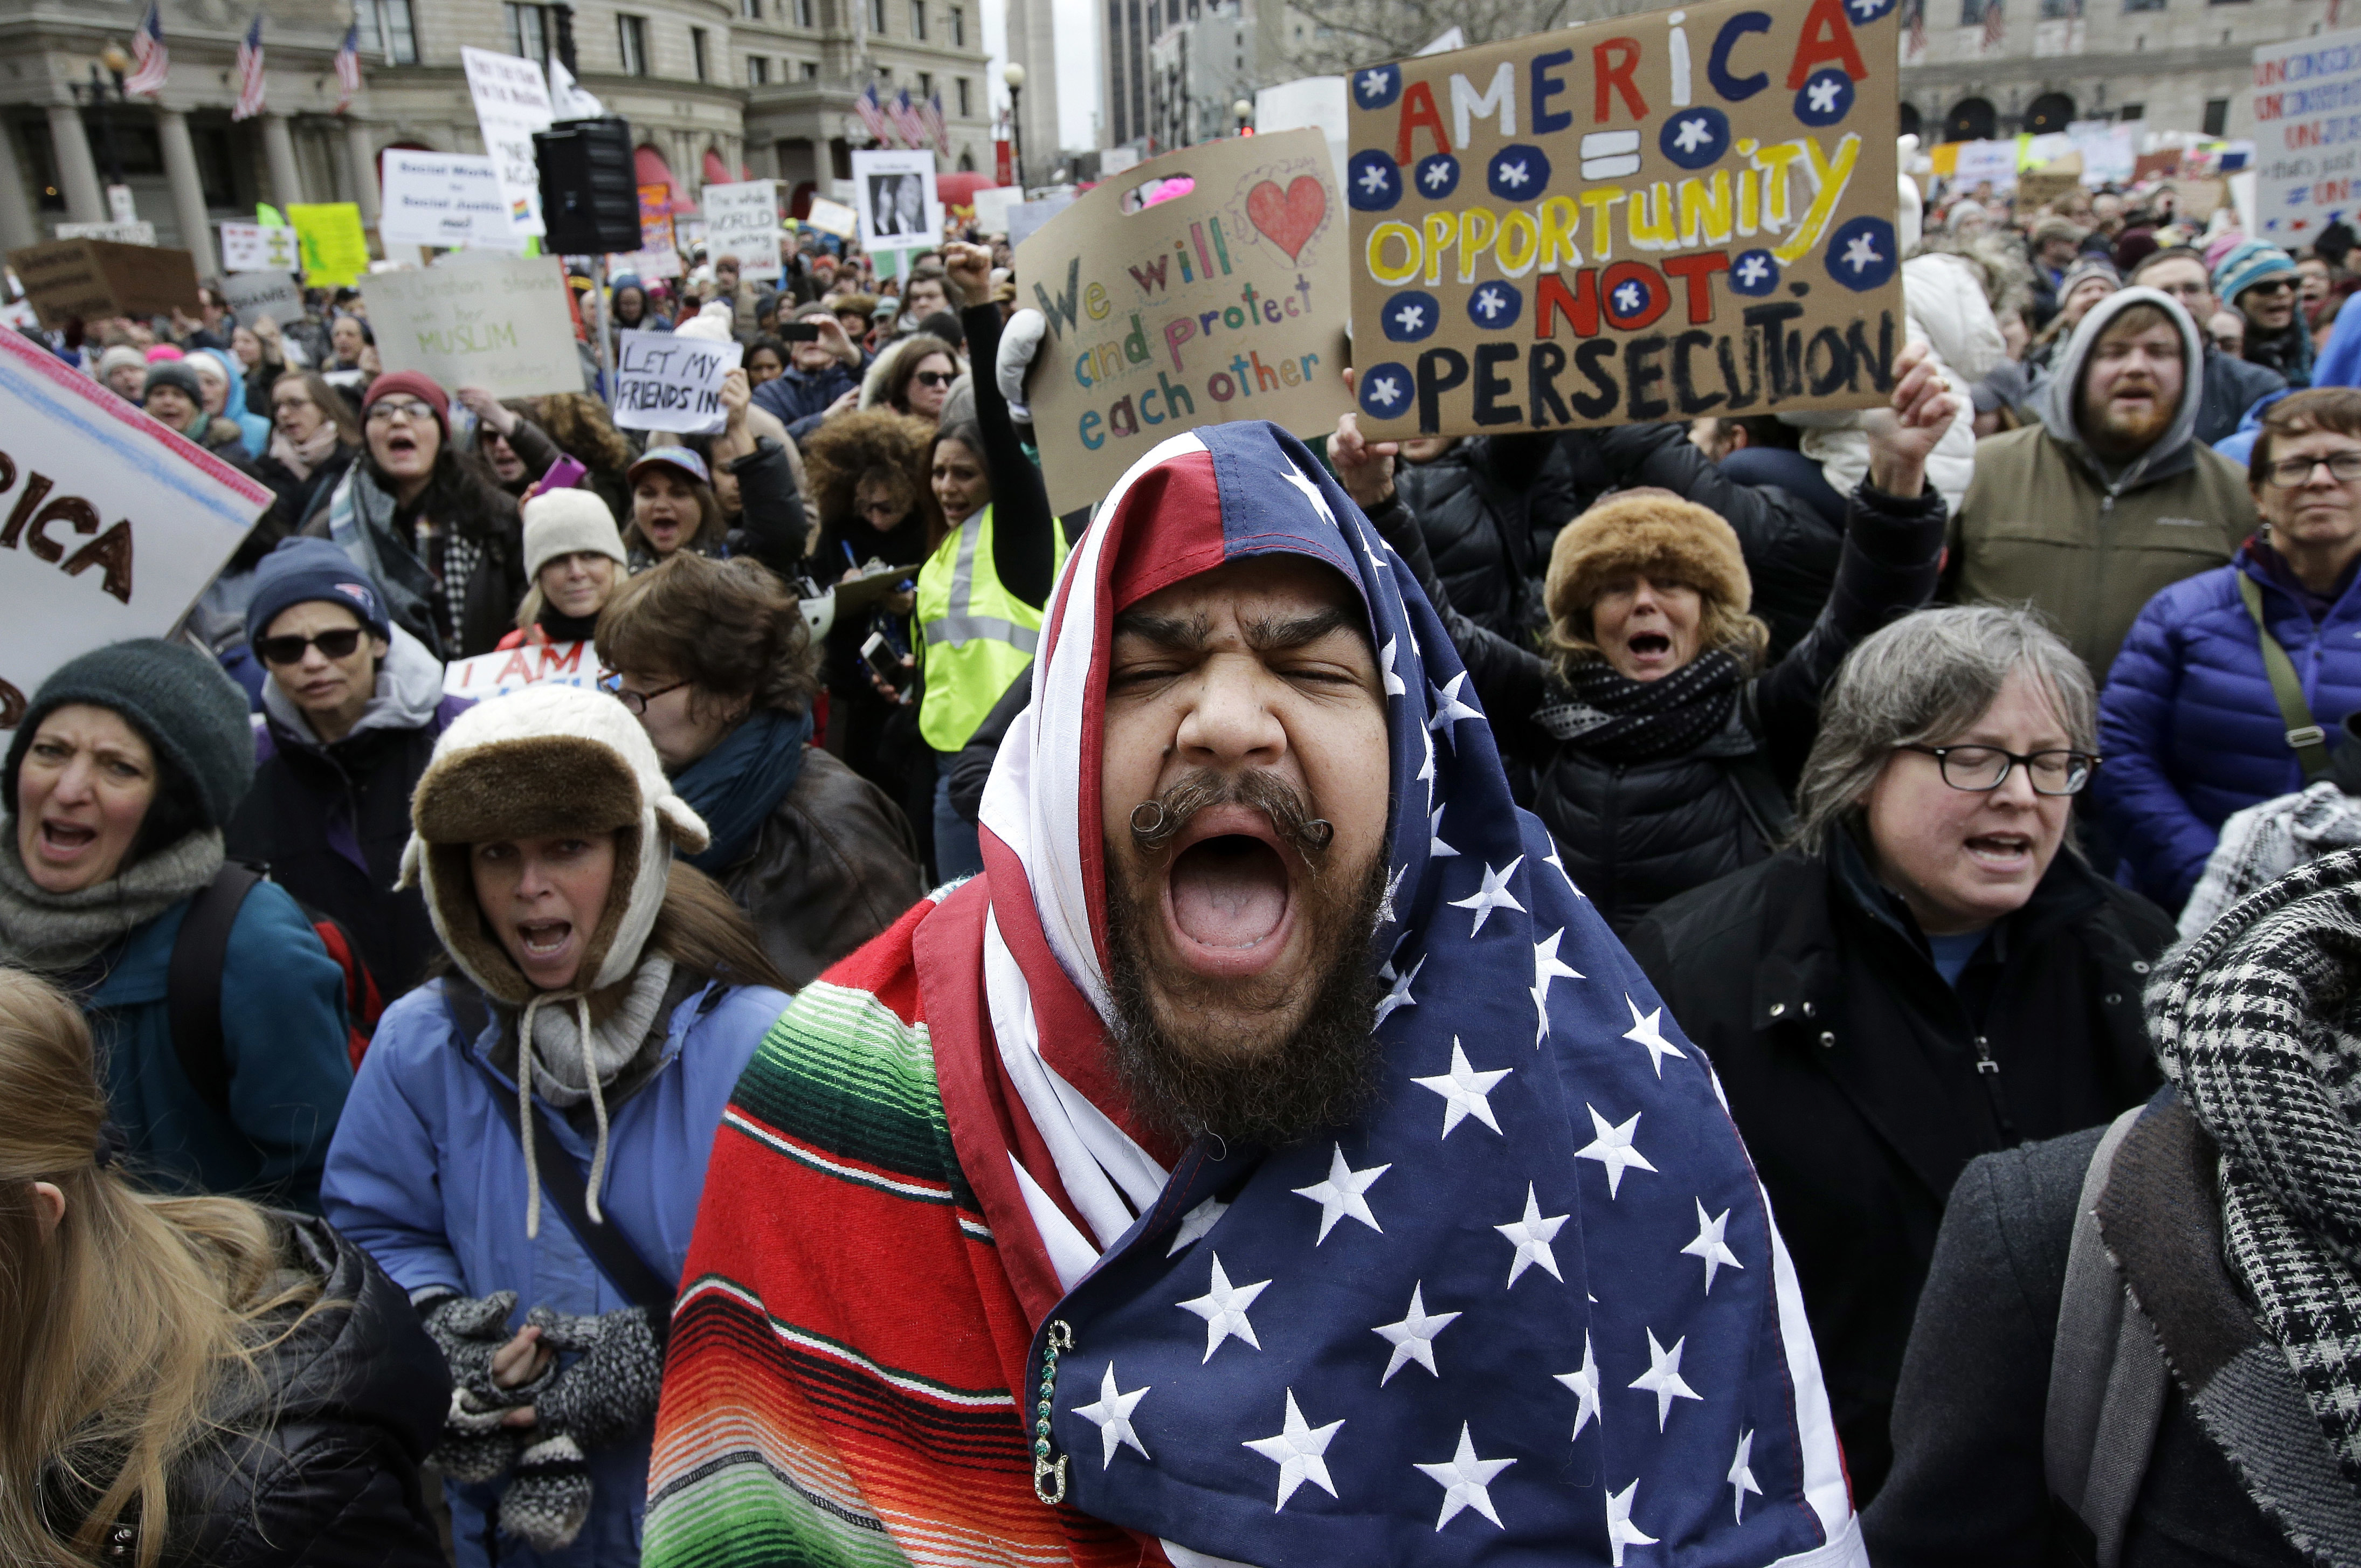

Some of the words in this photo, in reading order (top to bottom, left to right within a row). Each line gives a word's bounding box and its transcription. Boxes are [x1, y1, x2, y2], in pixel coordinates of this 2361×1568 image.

[710, 209, 773, 231] WORLD
[1033, 255, 1111, 341] We
[1128, 217, 1233, 296] will
[1536, 251, 1730, 340] NOT
[417, 320, 517, 355] MUSLIM
[1075, 314, 1151, 388] and
[1164, 273, 1313, 374] protect
[623, 341, 681, 375] LET
[681, 352, 721, 385] MY
[618, 379, 693, 411] FRIENDS
[696, 389, 720, 413] IN
[1079, 371, 1196, 451] each
[1207, 350, 1320, 403] other
[462, 662, 473, 688] I
[495, 640, 584, 685] AM
